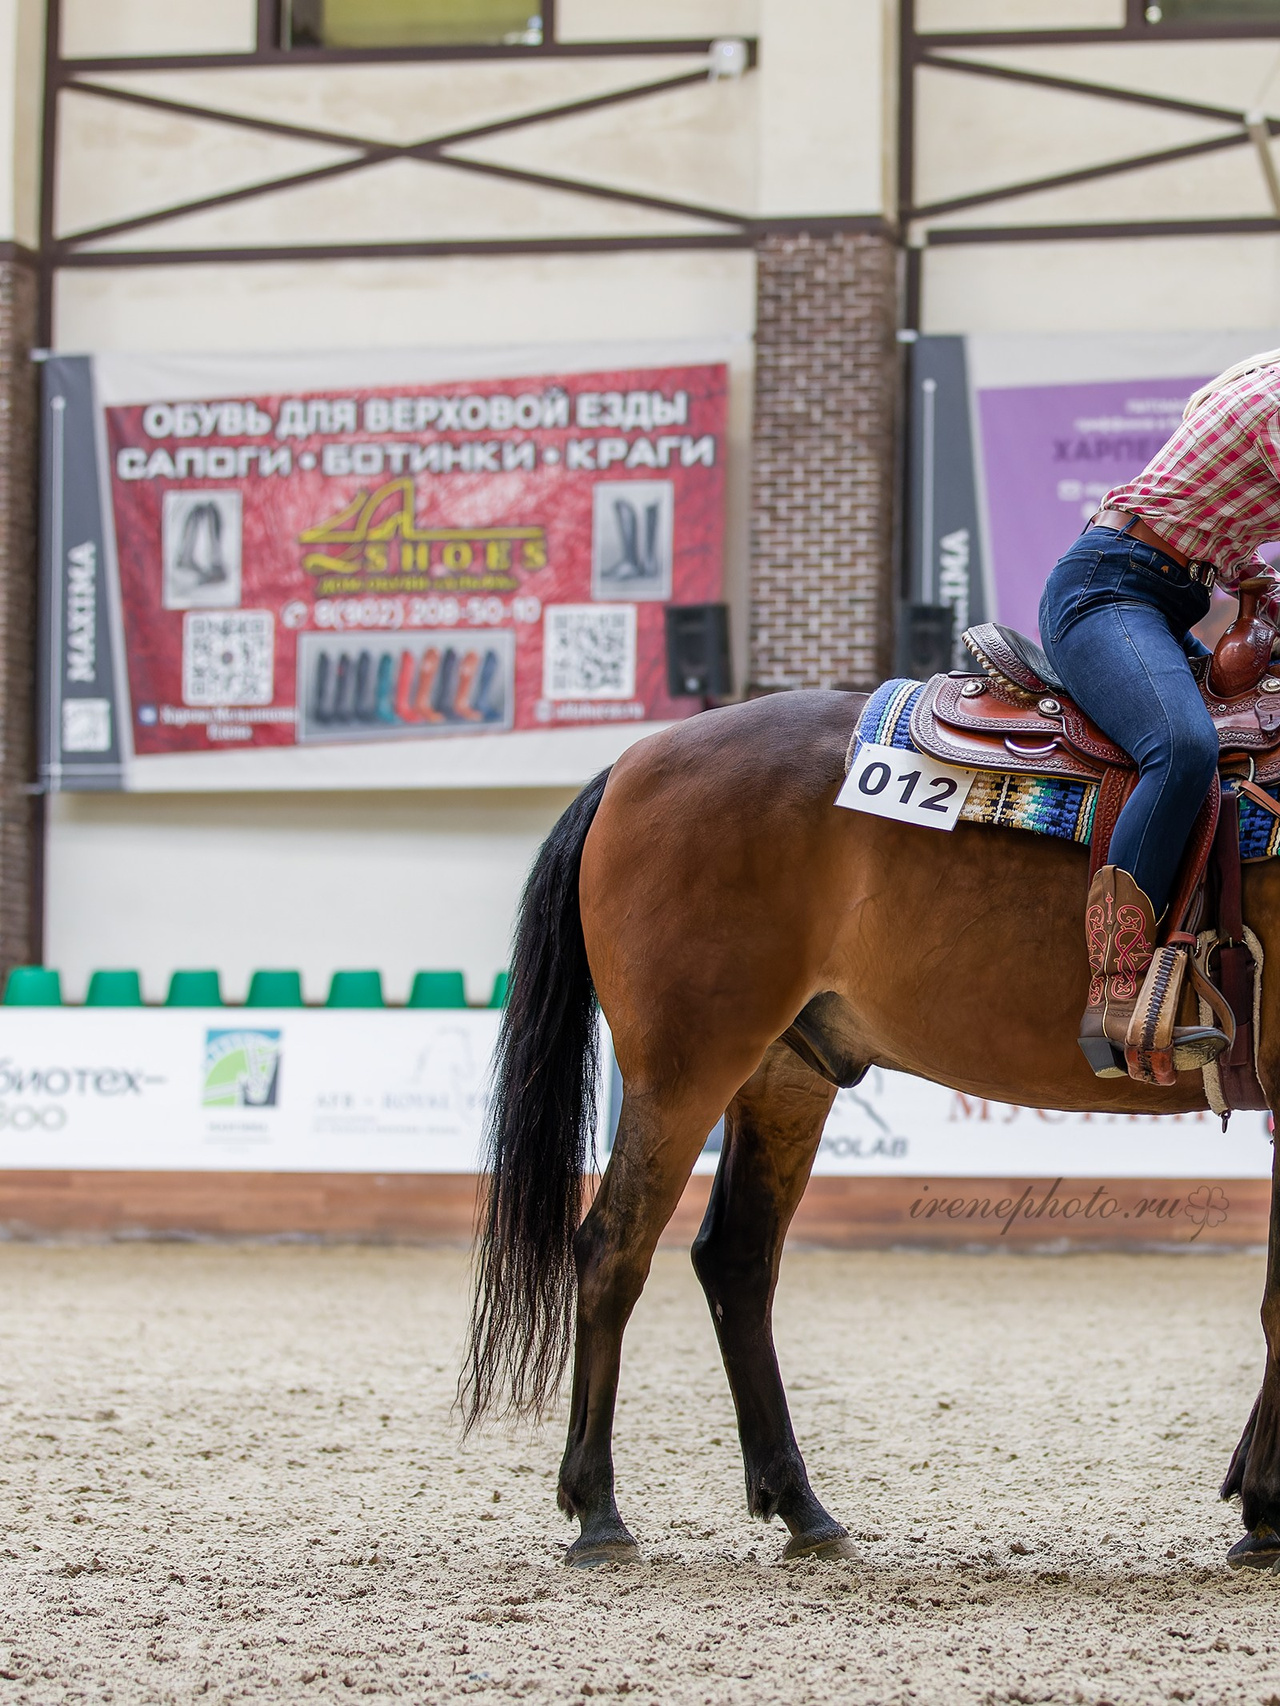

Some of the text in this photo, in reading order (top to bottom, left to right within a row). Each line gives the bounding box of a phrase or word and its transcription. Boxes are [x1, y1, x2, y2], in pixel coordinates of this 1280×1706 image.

[143, 386, 688, 441] ОБУВЬ ДЛЯ ВЕРХОВОЙ ЕЗДЫ
[117, 436, 715, 480] САПОГИ БОТИНКИ КРАГИ
[67, 541, 96, 683] MAXIMA
[857, 761, 958, 813] 012
